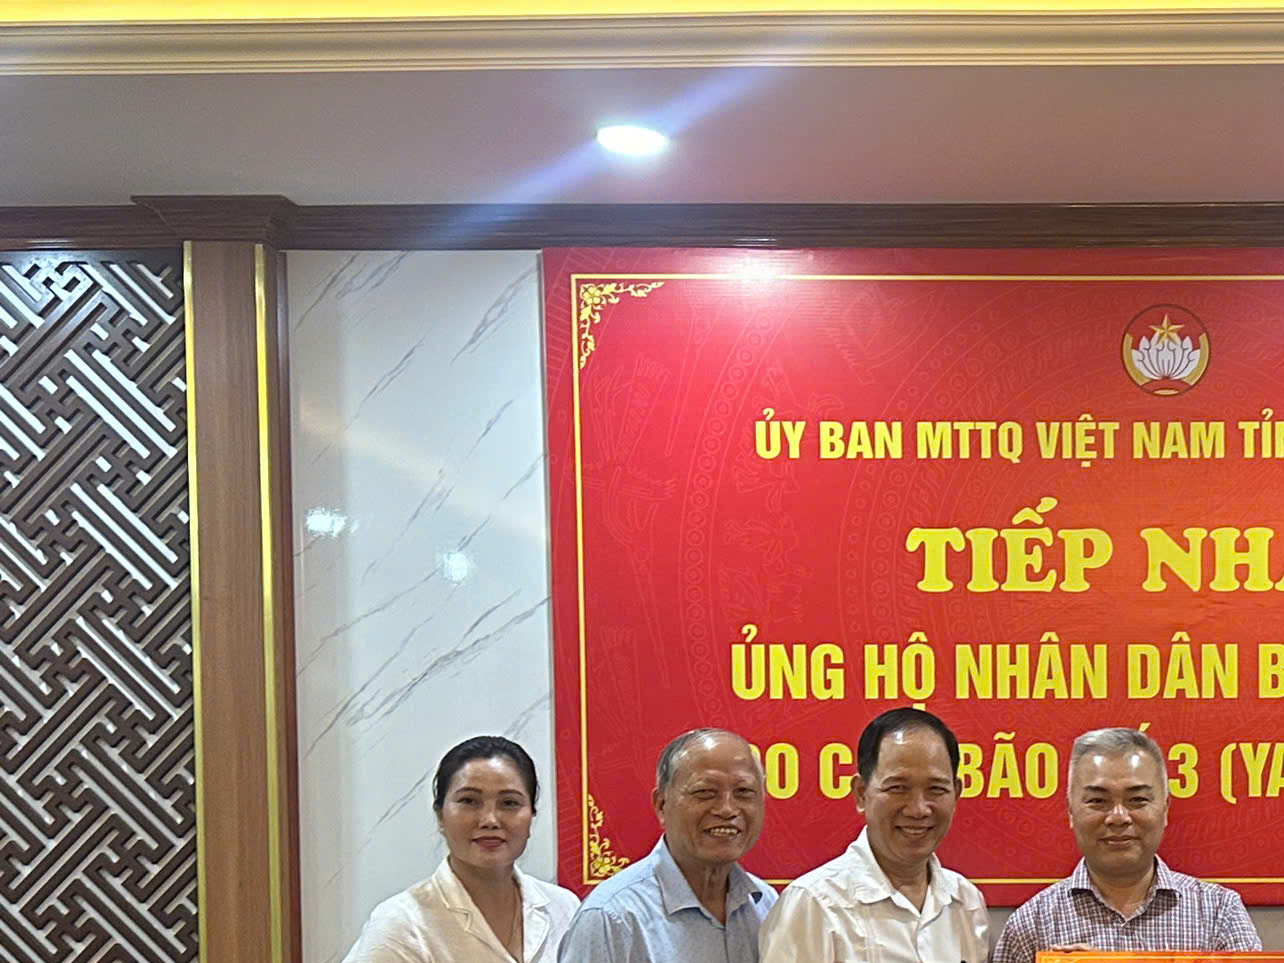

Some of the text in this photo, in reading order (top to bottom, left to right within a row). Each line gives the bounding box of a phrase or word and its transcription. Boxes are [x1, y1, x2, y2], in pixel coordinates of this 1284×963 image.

[755, 408, 805, 460] ỦY
[819, 421, 902, 459] BAN
[916, 421, 1023, 463] MTTQ
[1036, 413, 1120, 467] VIỆT
[1133, 421, 1225, 459] NAM
[905, 497, 1113, 593] TIẾP
[731, 624, 845, 700] ỦNG
[864, 631, 936, 708] HỘ
[955, 631, 1108, 699] NHÂN
[1127, 631, 1238, 699] DÂN
[750, 743, 799, 799] O
[958, 731, 1058, 799] BÃO
[1168, 743, 1199, 798] 3
